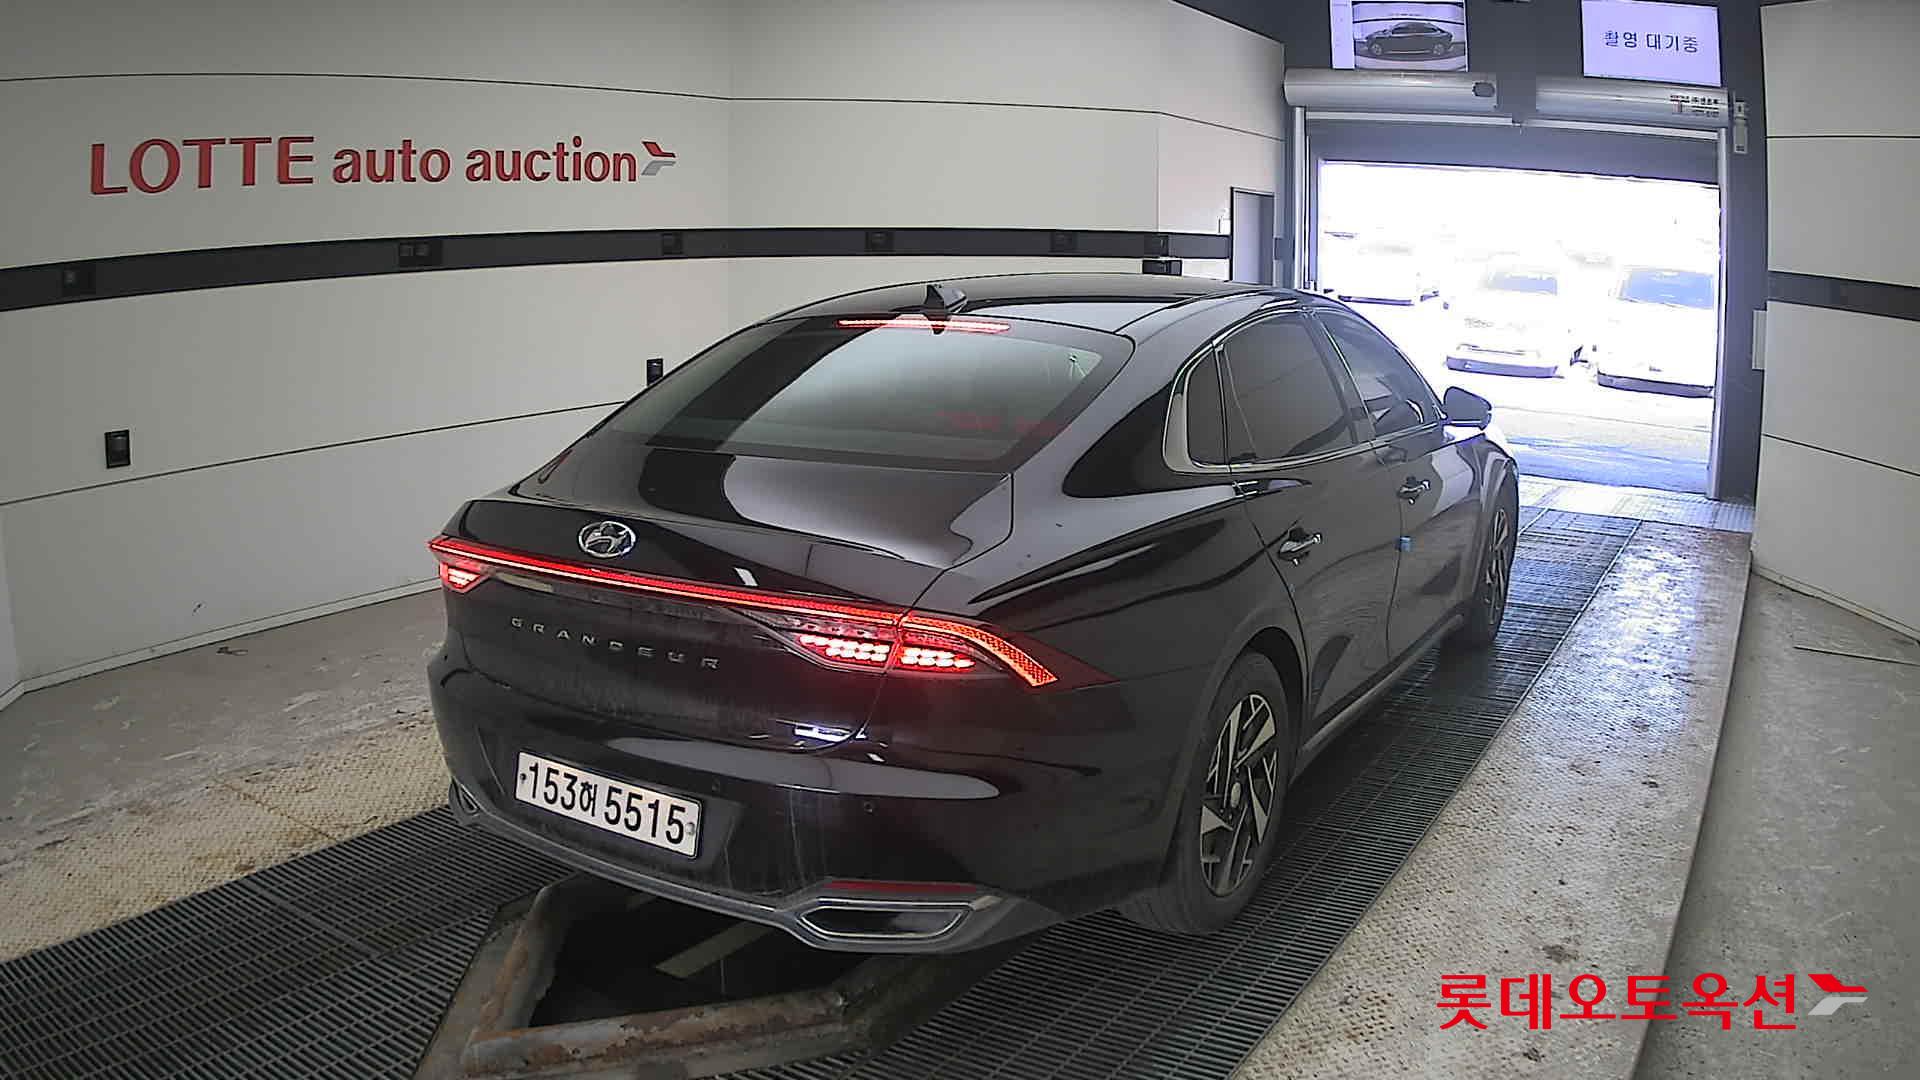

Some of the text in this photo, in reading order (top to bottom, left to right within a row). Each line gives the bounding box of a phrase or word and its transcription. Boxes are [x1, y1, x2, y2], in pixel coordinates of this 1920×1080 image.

[1646, 33, 1698, 53] 대기중
[90, 136, 638, 195] LOTTE auto auction
[511, 617, 720, 669] GRANDEUR
[604, 785, 687, 845] 5515
